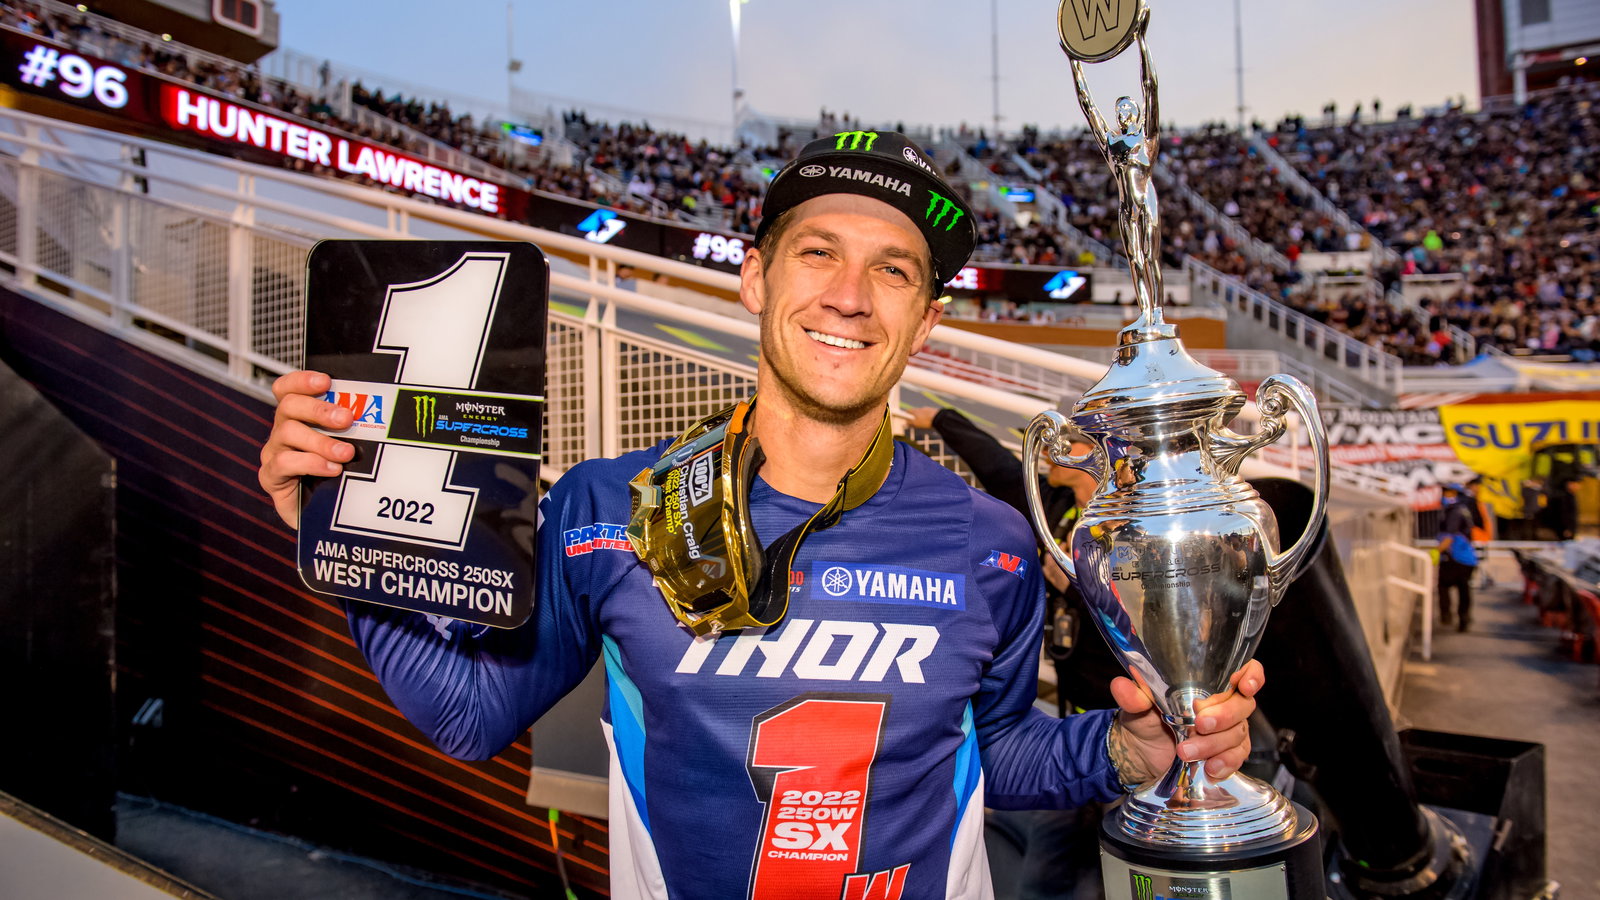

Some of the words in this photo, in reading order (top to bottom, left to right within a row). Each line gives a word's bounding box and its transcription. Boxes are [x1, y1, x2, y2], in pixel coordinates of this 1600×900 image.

[18, 44, 128, 109] #96
[176, 89, 331, 166] HUNTER
[338, 142, 499, 213] LAWRENCE
[828, 166, 912, 197] YAMAHA
[692, 232, 745, 265] #96
[331, 251, 511, 551] 1
[455, 401, 506, 416] MONSTER
[435, 420, 529, 439] SUPERCROSS
[463, 413, 498, 422] ENERGY
[460, 435, 501, 448] Championship
[664, 468, 676, 494] West
[678, 464, 690, 520] Christian
[694, 459, 709, 497] 100%
[376, 496, 435, 525] 2022
[671, 490, 681, 510] 250
[672, 511, 683, 528] SX
[682, 521, 701, 560] Craig
[314, 540, 349, 560] AMA
[351, 545, 460, 580] SUPERCROSS
[463, 565, 514, 589] 250SX
[978, 549, 1029, 581] AMA
[1111, 563, 1221, 581] SUPERCROSS
[313, 558, 376, 590] WEST
[381, 571, 513, 616] CHAMPION
[855, 569, 957, 605] YAMAHA
[780, 790, 861, 806] 2022
[776, 807, 857, 821] 250W
[771, 822, 852, 851] SX
[768, 850, 849, 862] CHAMPION
